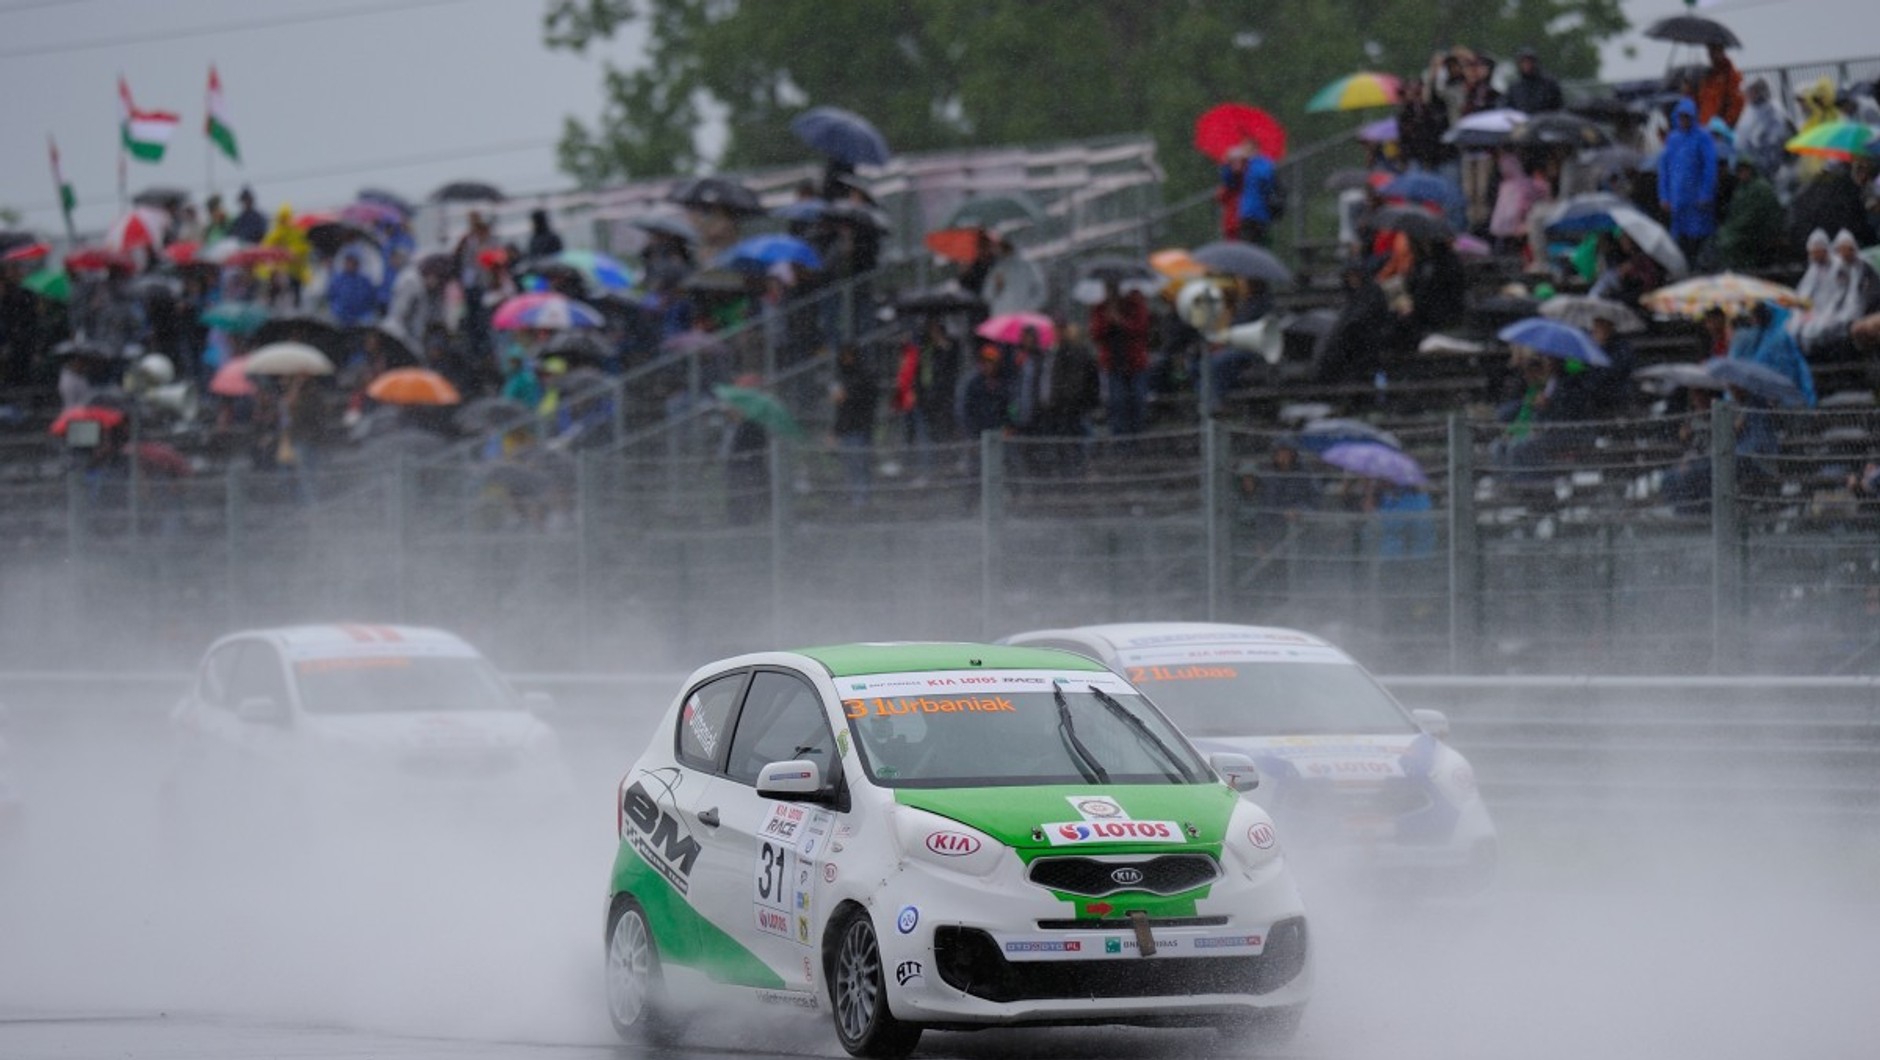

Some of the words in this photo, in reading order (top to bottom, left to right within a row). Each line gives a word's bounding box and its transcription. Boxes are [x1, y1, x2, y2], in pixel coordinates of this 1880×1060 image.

[927, 679, 956, 687] KIA
[959, 677, 997, 685] LOTOS
[623, 780, 702, 877] BM
[766, 818, 797, 836] RACE
[1092, 822, 1171, 838] LOTOS
[936, 834, 970, 851] KIA
[758, 841, 785, 903] 31
[1115, 870, 1139, 882] KIA
